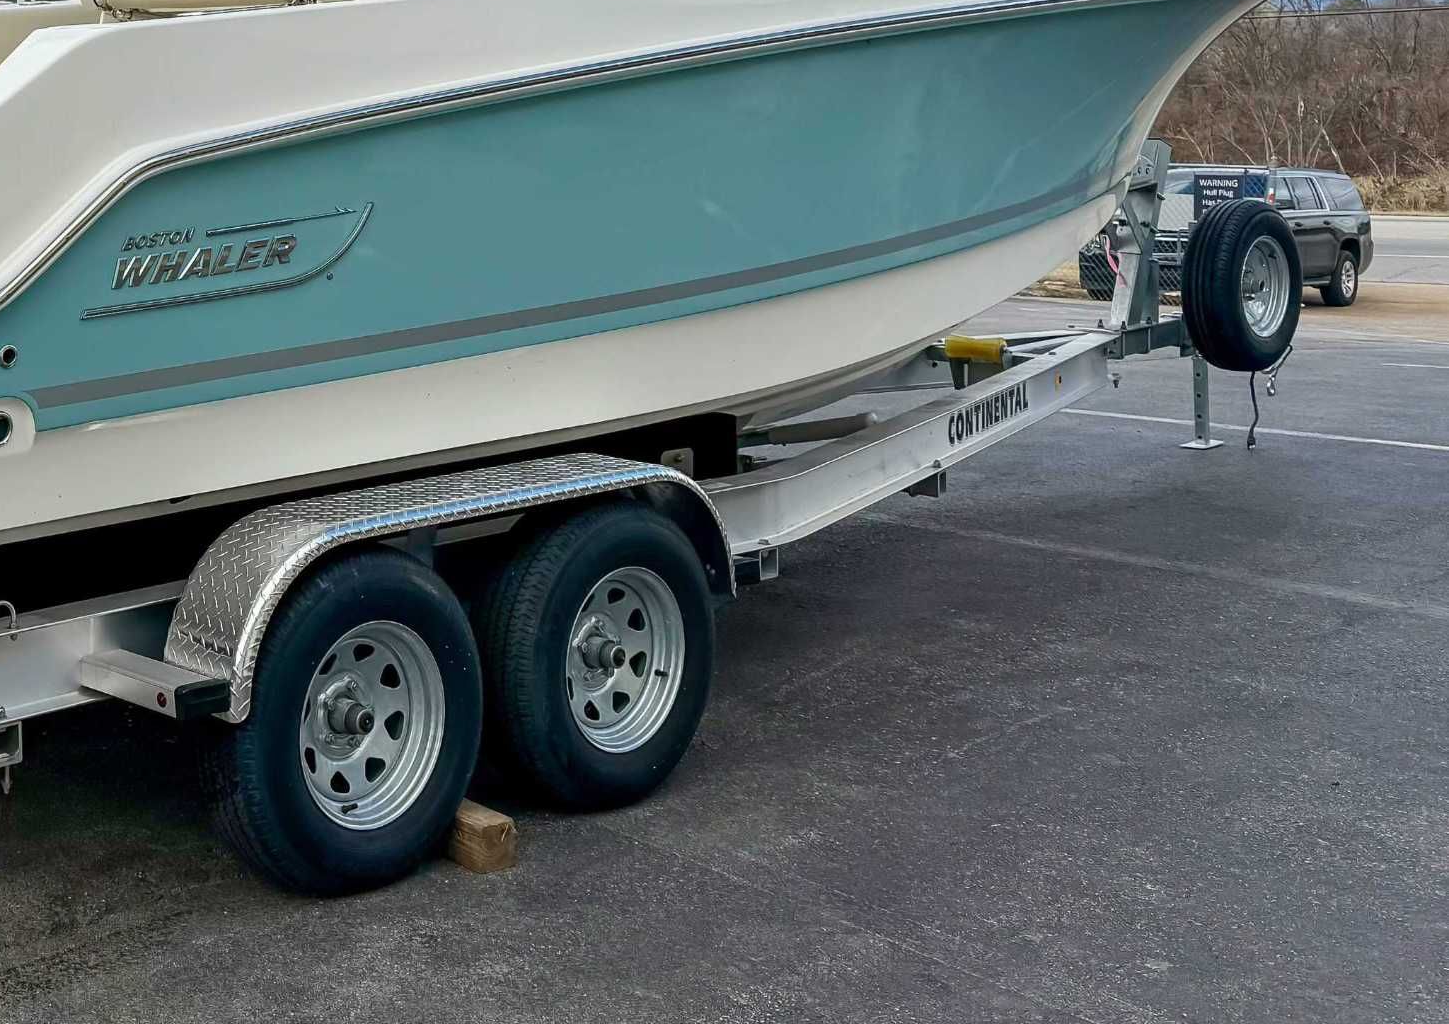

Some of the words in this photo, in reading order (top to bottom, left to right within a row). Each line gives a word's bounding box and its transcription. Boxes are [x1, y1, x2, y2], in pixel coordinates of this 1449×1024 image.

[1199, 179, 1238, 188] WARNING
[1203, 189, 1218, 197] Hull
[121, 226, 196, 252] BOSTON
[111, 233, 297, 290] WHALER
[948, 380, 1030, 446] CONTINENTAL
